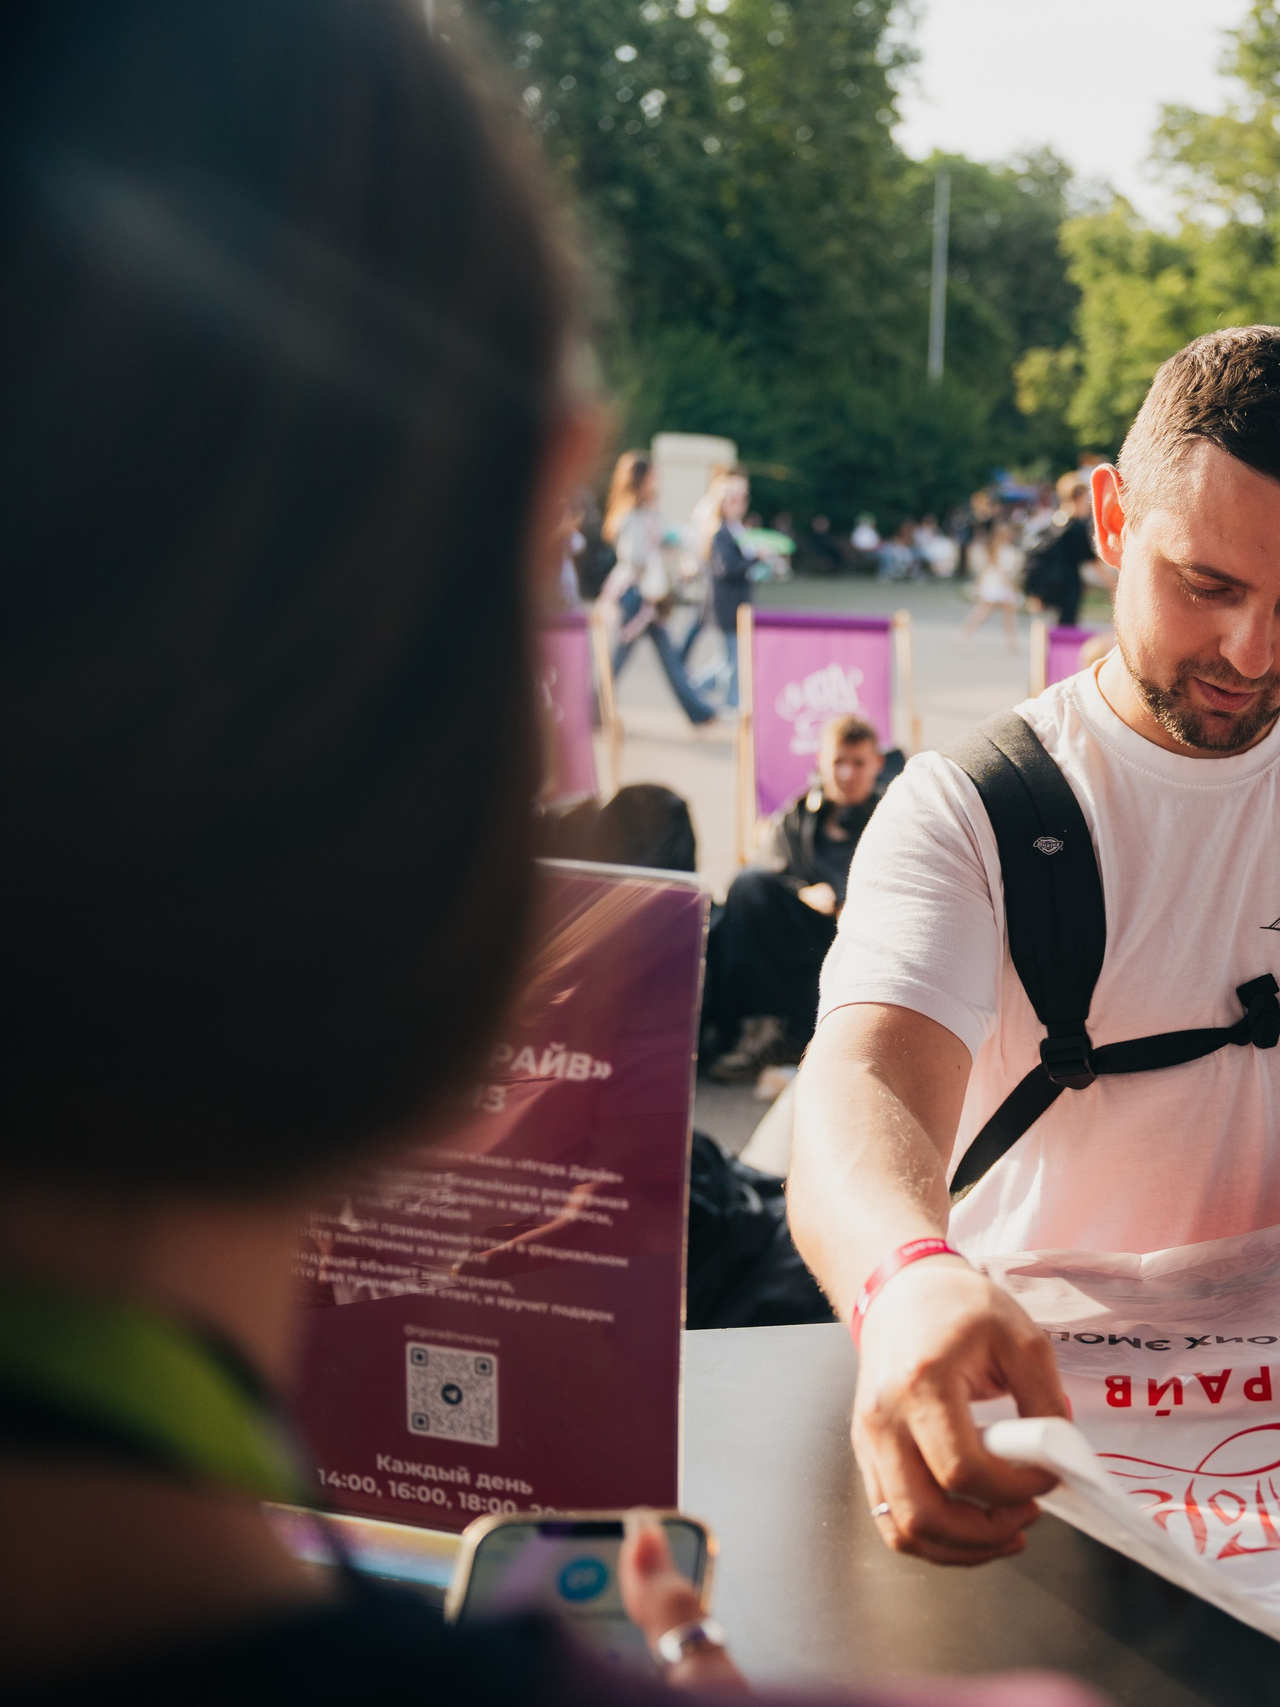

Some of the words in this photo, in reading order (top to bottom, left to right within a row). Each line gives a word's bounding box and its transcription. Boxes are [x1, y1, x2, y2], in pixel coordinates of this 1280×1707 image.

[492, 1041, 613, 1081] РАЙВ»
[301, 1228, 333, 1240] осте
[550, 1303, 616, 1324] подарок
[1048, 1330, 1172, 1352] ЭМОЦ
[317, 1468, 383, 1498] 14:00,
[388, 1480, 453, 1510] 16:00,
[375, 1453, 471, 1487] Каждый
[475, 1472, 534, 1496] день
